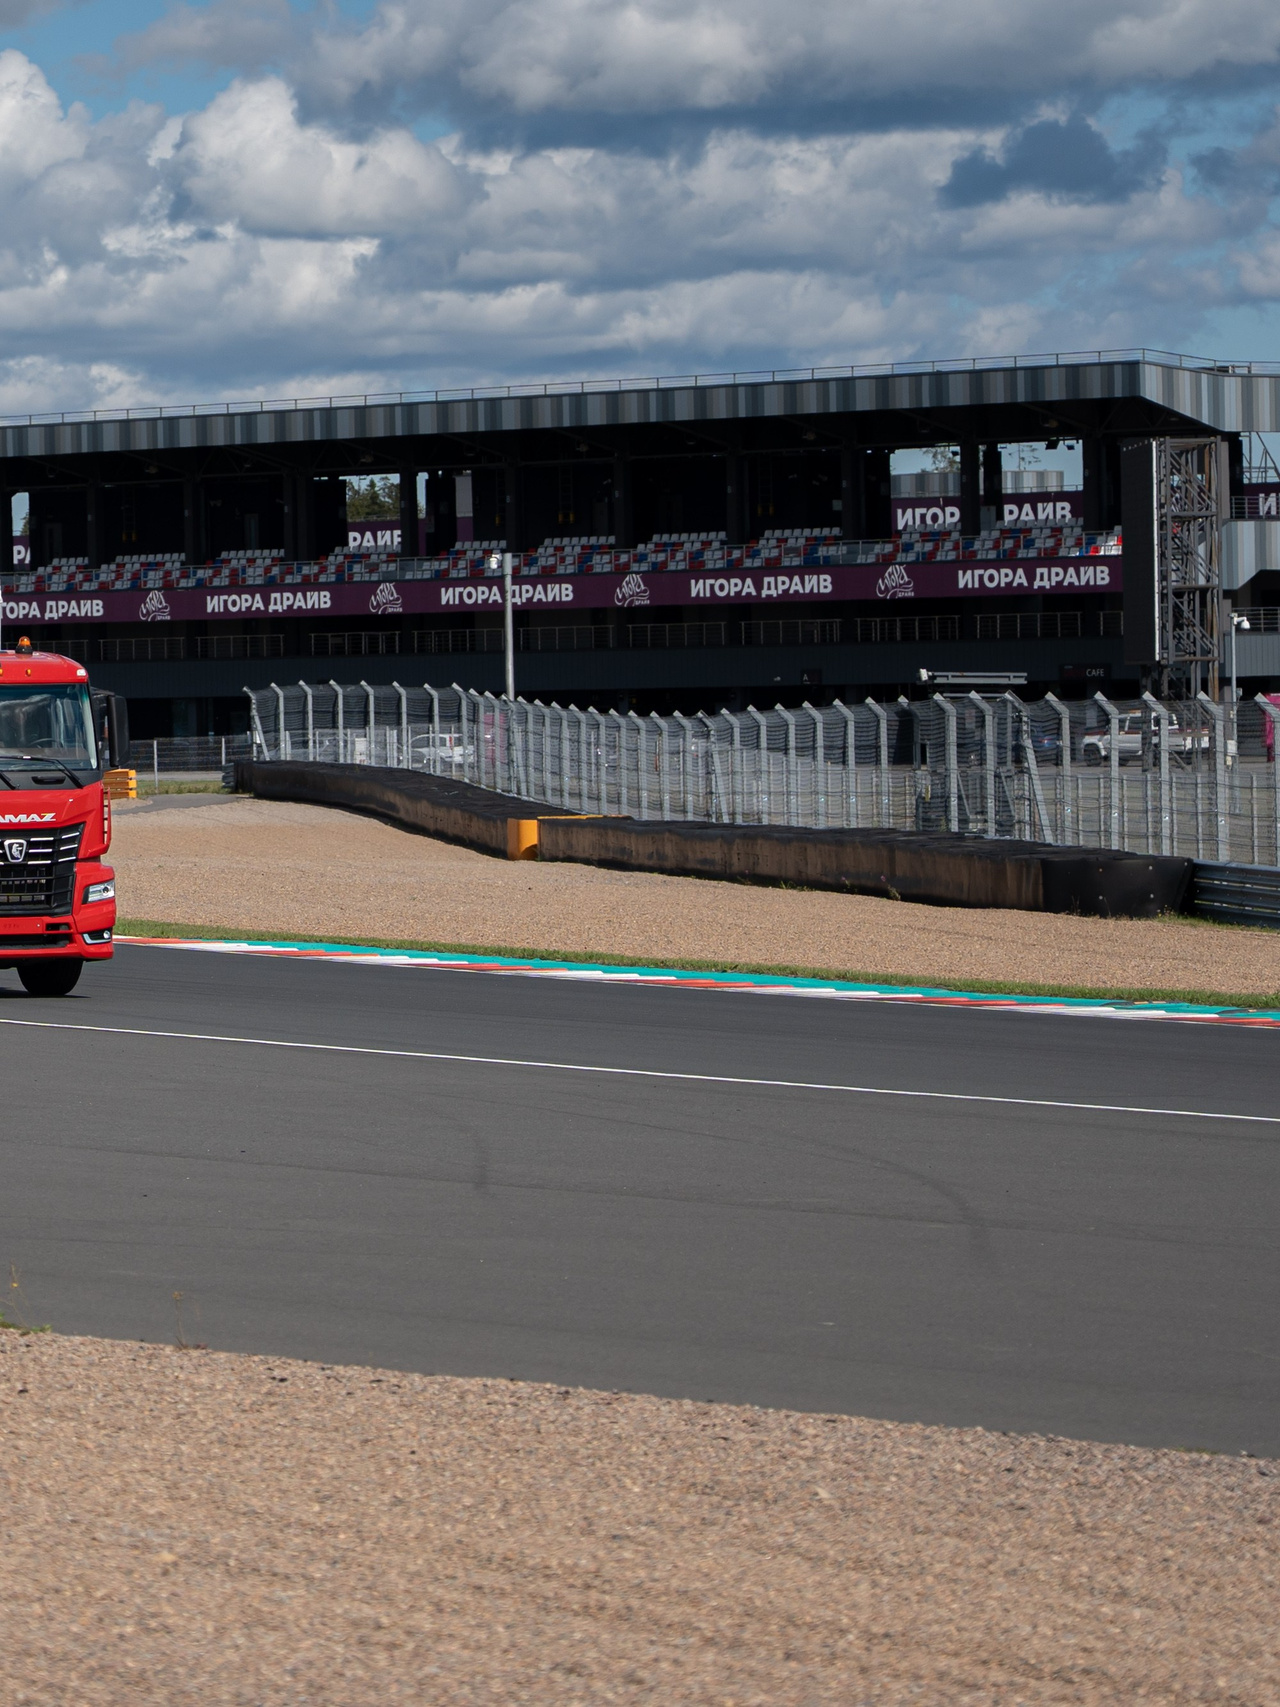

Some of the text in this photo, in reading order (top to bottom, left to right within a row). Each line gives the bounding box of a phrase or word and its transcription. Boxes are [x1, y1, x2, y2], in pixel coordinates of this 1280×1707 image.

[897, 502, 1072, 530] ИГОР РАЙВ
[691, 574, 832, 598] ИГОРА ДРАЙВ
[958, 566, 1110, 589] ИГОРА ДРАЙВ
[207, 591, 331, 612] ИГОРА ДРАЙВ
[441, 584, 573, 605] ИГОРА ДРАЙВ
[0, 600, 103, 620] ГОРА ДРАЙВ
[1086, 668, 1104, 677] CAFE
